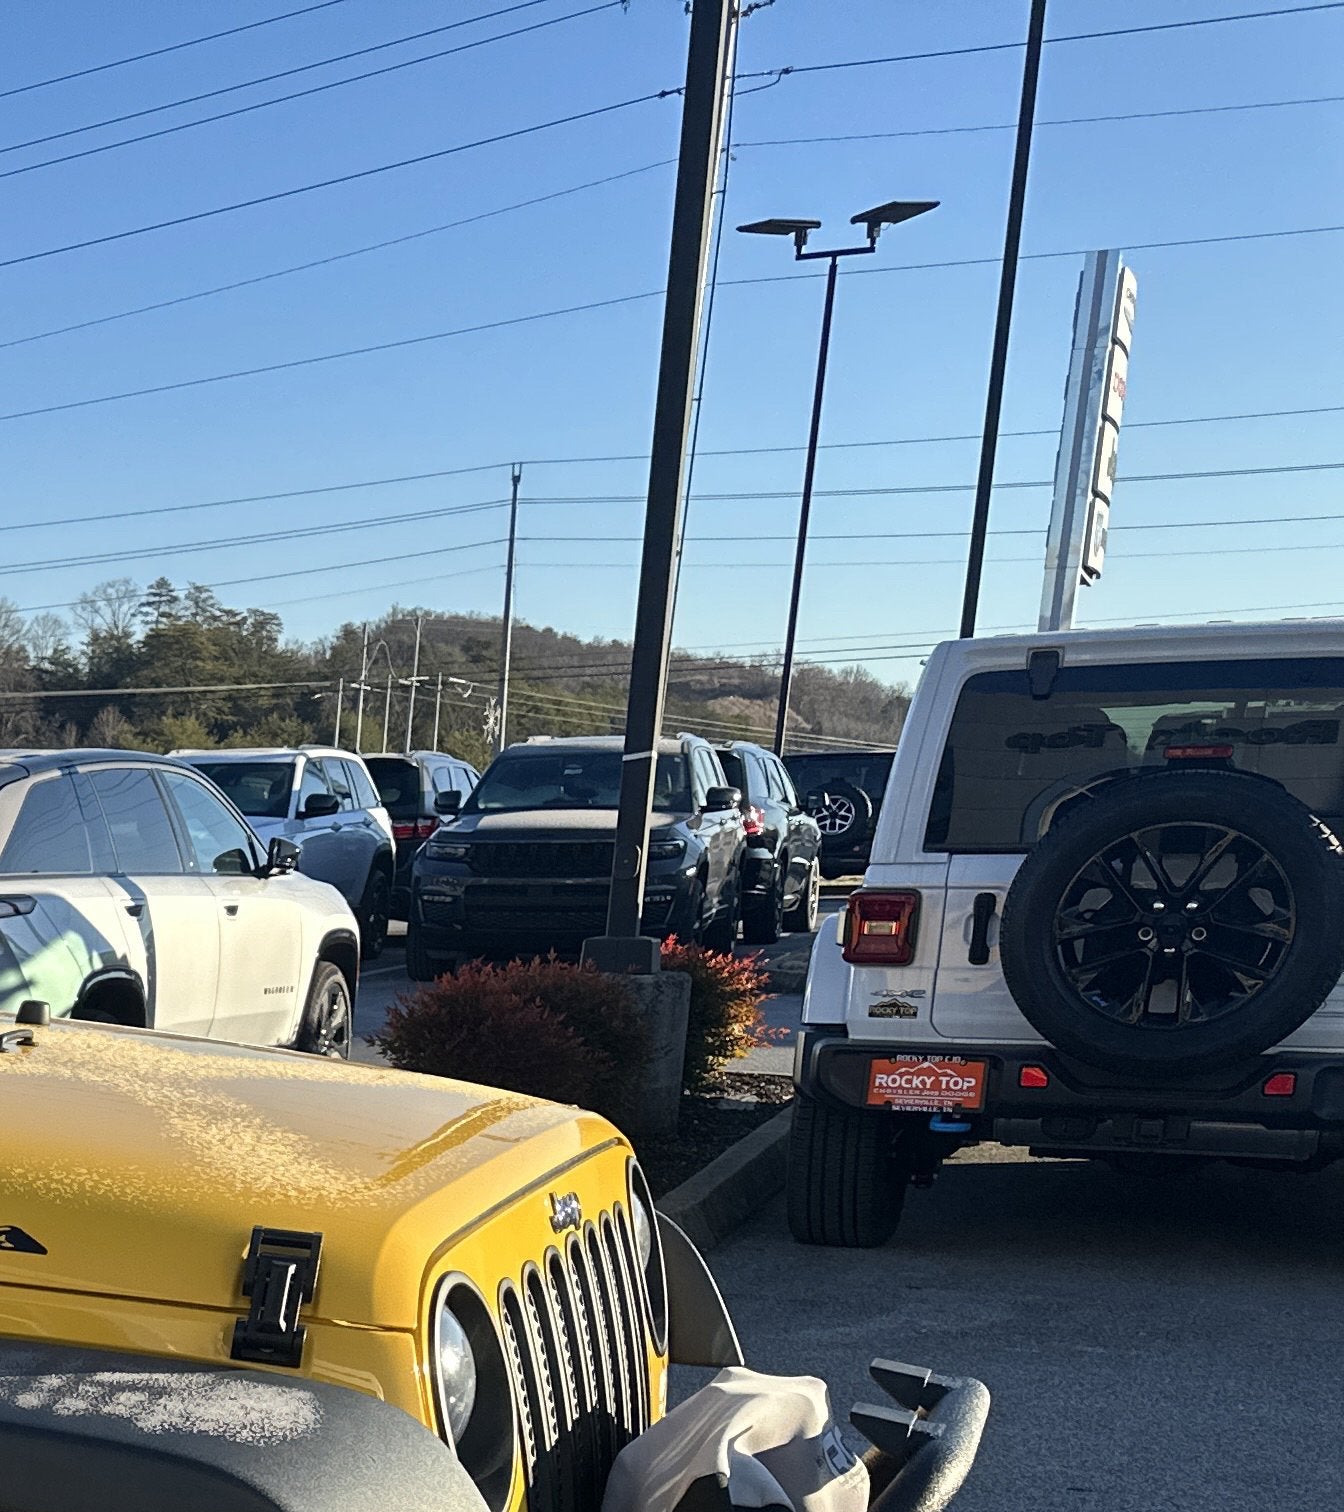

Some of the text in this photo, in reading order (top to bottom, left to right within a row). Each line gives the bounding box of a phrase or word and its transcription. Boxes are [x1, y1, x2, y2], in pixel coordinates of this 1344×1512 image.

[870, 1006, 917, 1016] ROCKY TOP
[874, 1073, 976, 1090] ROCKY TOP
